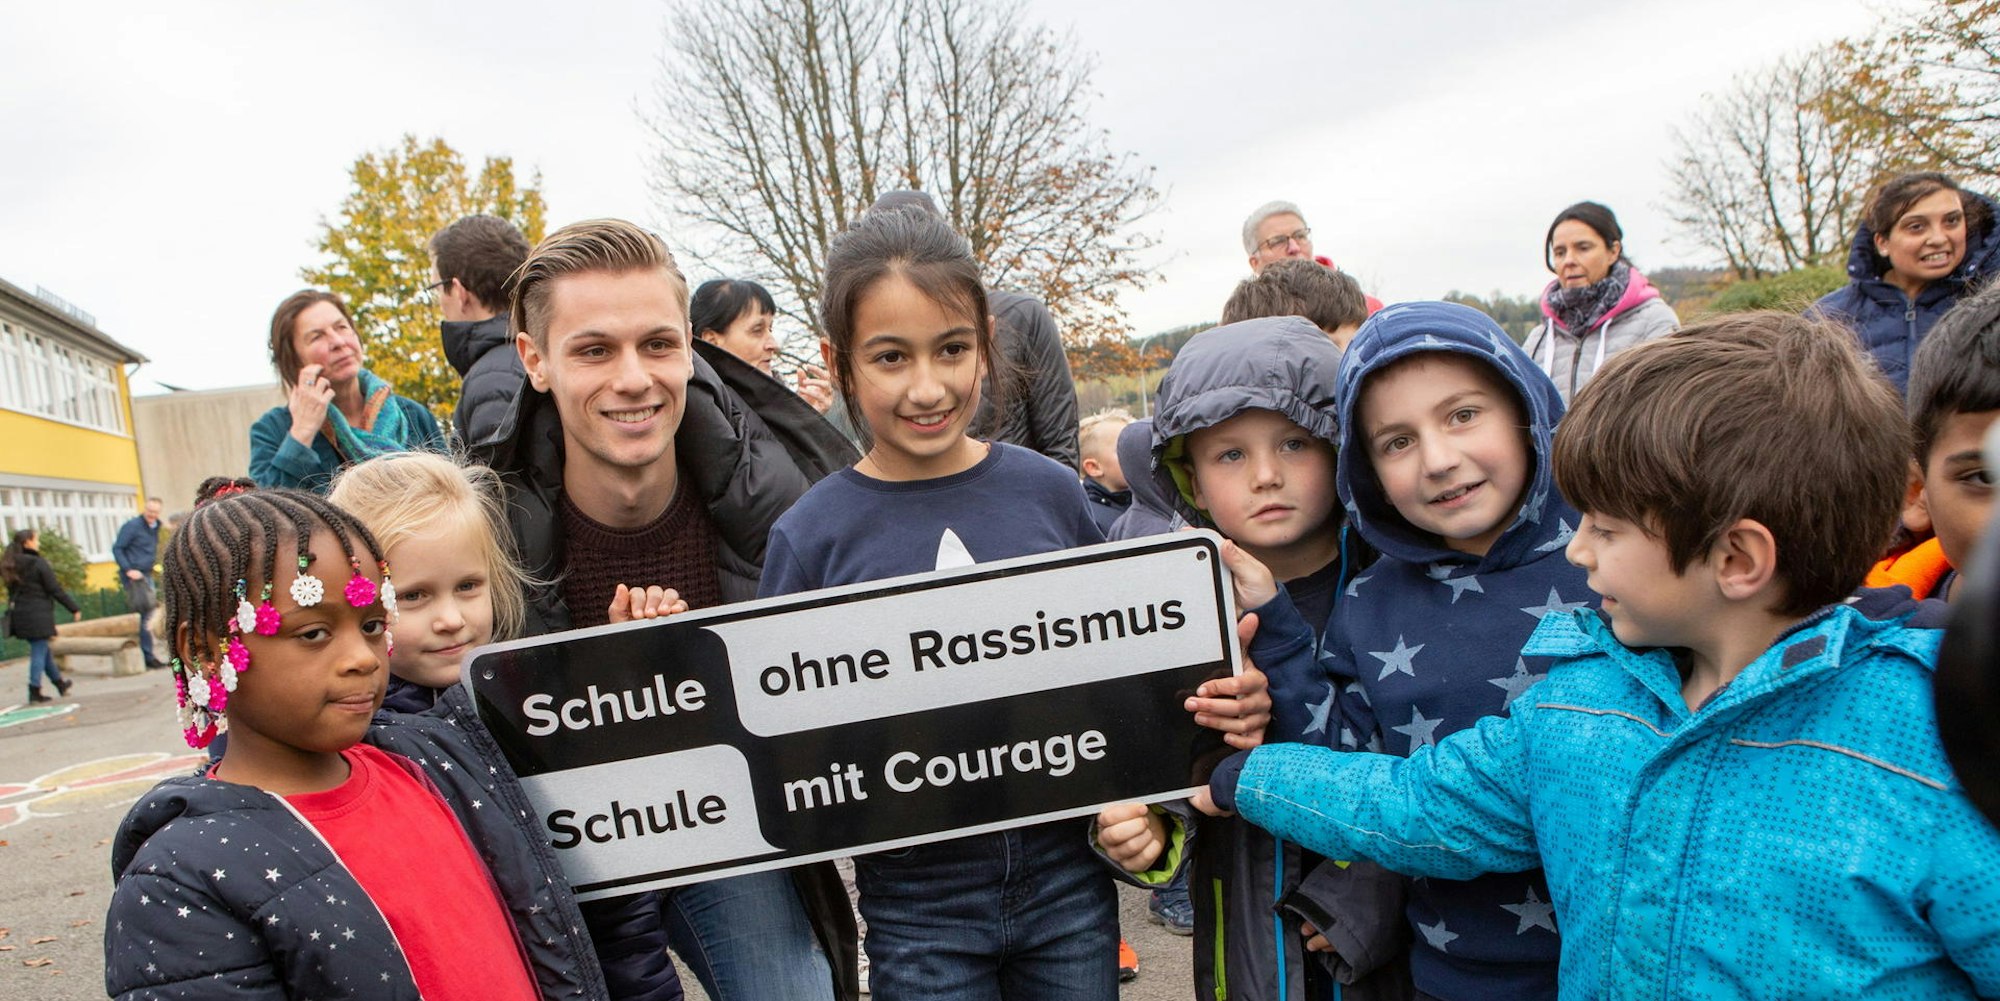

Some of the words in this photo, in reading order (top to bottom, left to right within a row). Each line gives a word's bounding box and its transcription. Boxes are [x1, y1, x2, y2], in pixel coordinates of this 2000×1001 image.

[522, 673, 707, 737] Schule
[759, 650, 890, 697] ohne
[909, 599, 1186, 672] Rassismus
[546, 789, 727, 850] Schule
[783, 762, 868, 812] mit
[884, 729, 1107, 793] Courage
